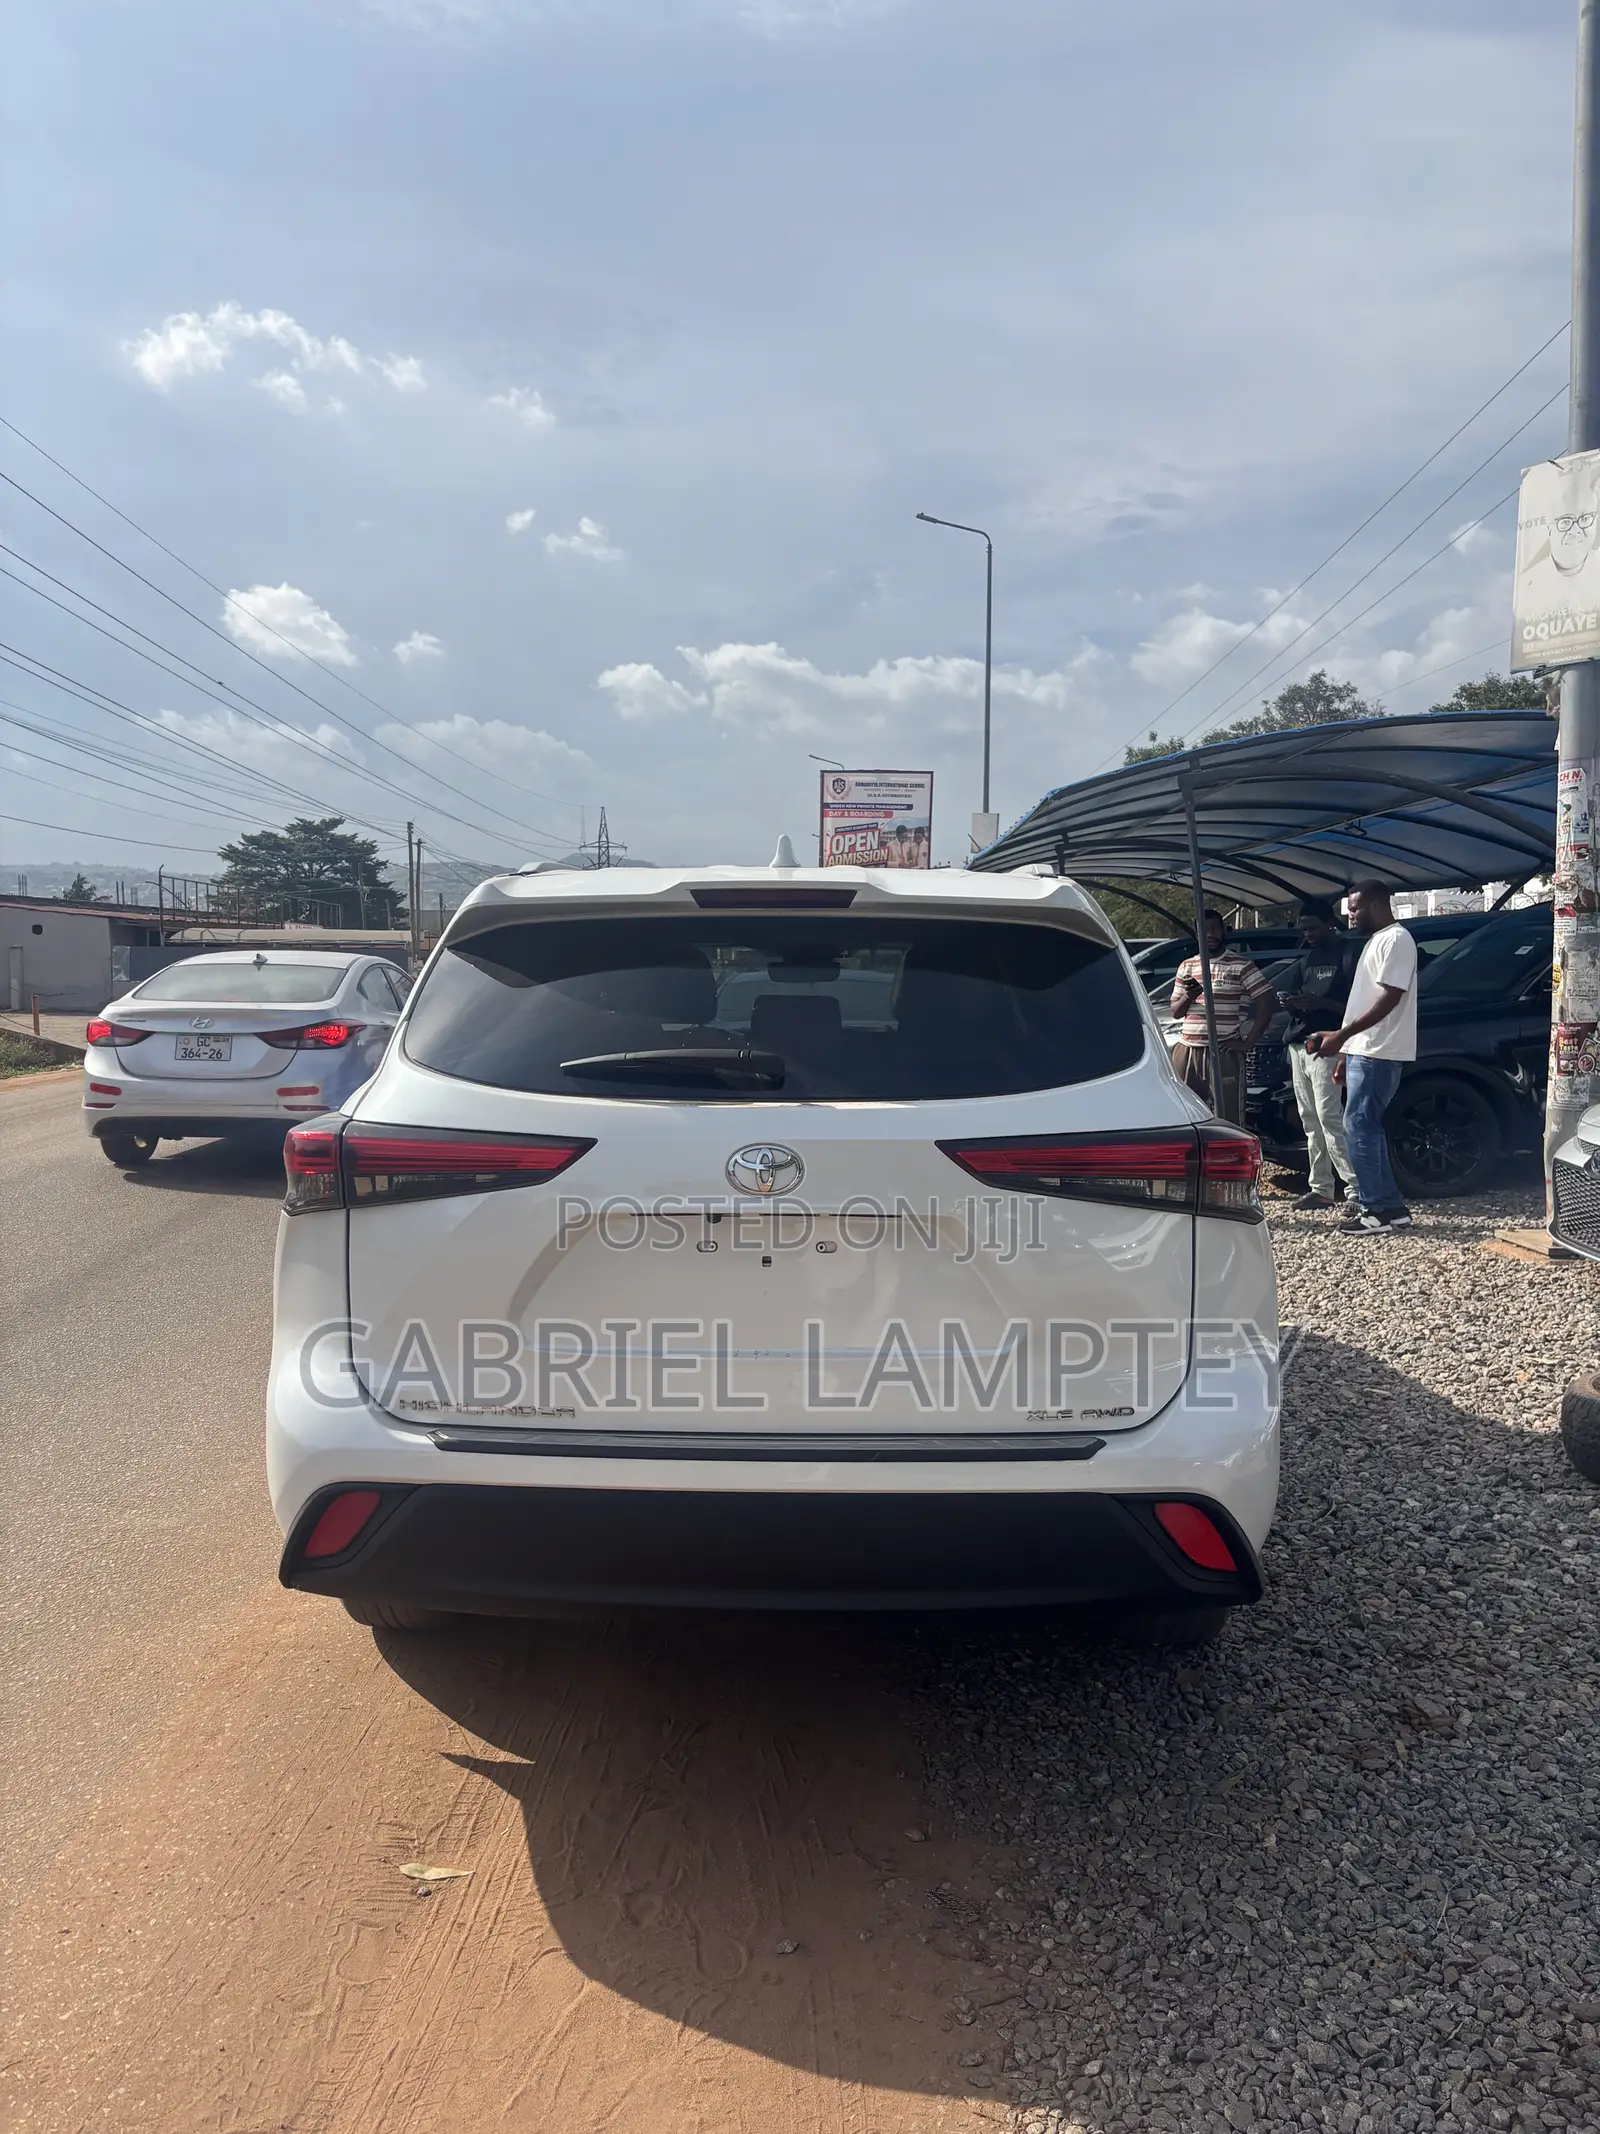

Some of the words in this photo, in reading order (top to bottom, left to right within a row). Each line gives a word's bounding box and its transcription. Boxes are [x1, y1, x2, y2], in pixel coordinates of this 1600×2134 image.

[1519, 515, 1547, 531] VOTE
[1522, 613, 1598, 640] OQUAYE
[831, 830, 879, 855] OPEN
[828, 849, 888, 867] ADMISSION
[196, 1036, 211, 1048] GC
[181, 1047, 223, 1060] 364-26
[1027, 1409, 1074, 1421] XLE
[1080, 1406, 1135, 1420] AWD
